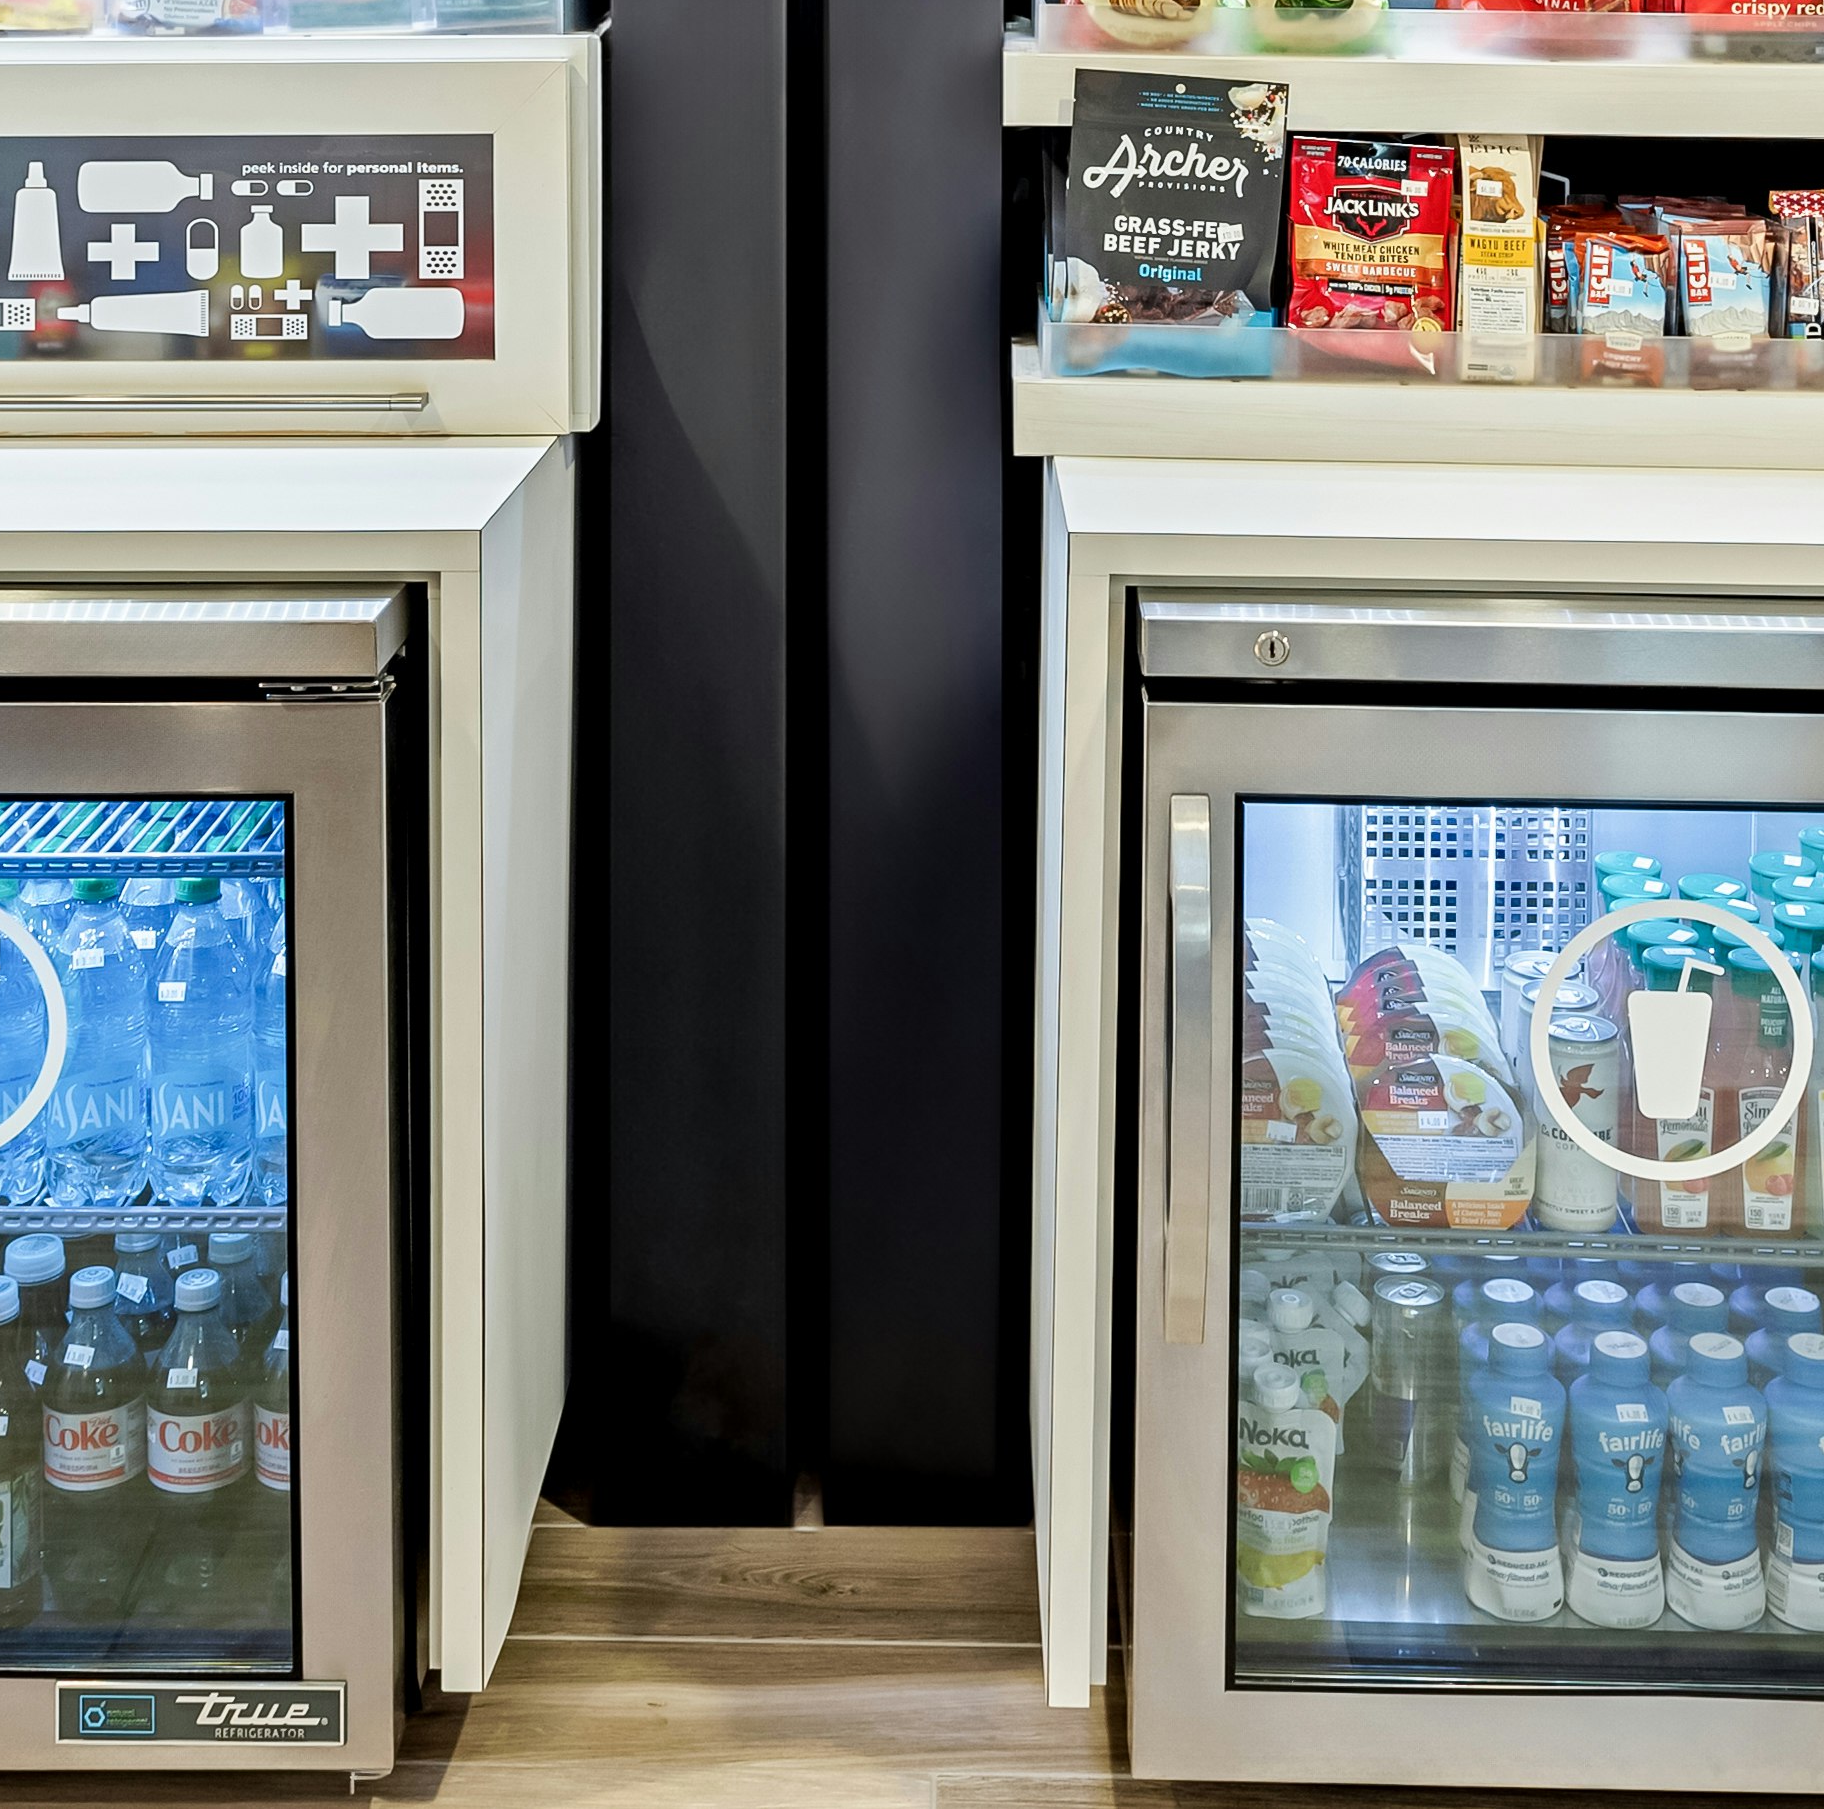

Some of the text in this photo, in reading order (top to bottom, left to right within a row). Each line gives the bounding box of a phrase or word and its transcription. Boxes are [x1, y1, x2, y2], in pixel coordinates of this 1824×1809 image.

[1143, 125, 1215, 143] COUNTRY
[242, 161, 464, 176] peek inside for personal items.
[1082, 133, 1250, 199] Archer
[1337, 155, 1408, 172] 70 CALORIES
[1138, 180, 1226, 193] PROVISIONS
[1323, 196, 1420, 219] JACK LINK'S
[1103, 233, 1242, 261] BEEF JERKY
[1323, 240, 1421, 256] WHITE MEAT CHICKEN
[1469, 237, 1527, 251] WAGYU BEEF
[1334, 251, 1410, 264] TENDER BITES
[1685, 241, 1708, 287] CLIF
[1138, 262, 1203, 283] Original
[1325, 261, 1417, 278] SWEET BARBECUE
[1590, 244, 1611, 289] CLIF
[1690, 287, 1709, 298] BAR
[1388, 1086, 1439, 1097] Balanced
[1389, 1095, 1429, 1106] Breaks
[1389, 1200, 1442, 1212] Balanced
[1389, 1209, 1430, 1221] Breaks
[45, 1414, 120, 1452] Coke
[158, 1417, 239, 1454] Coke
[1482, 1415, 1554, 1443] fairlife
[106, 1707, 136, 1718] natural
[214, 1727, 305, 1739] REFRIGERATOR
